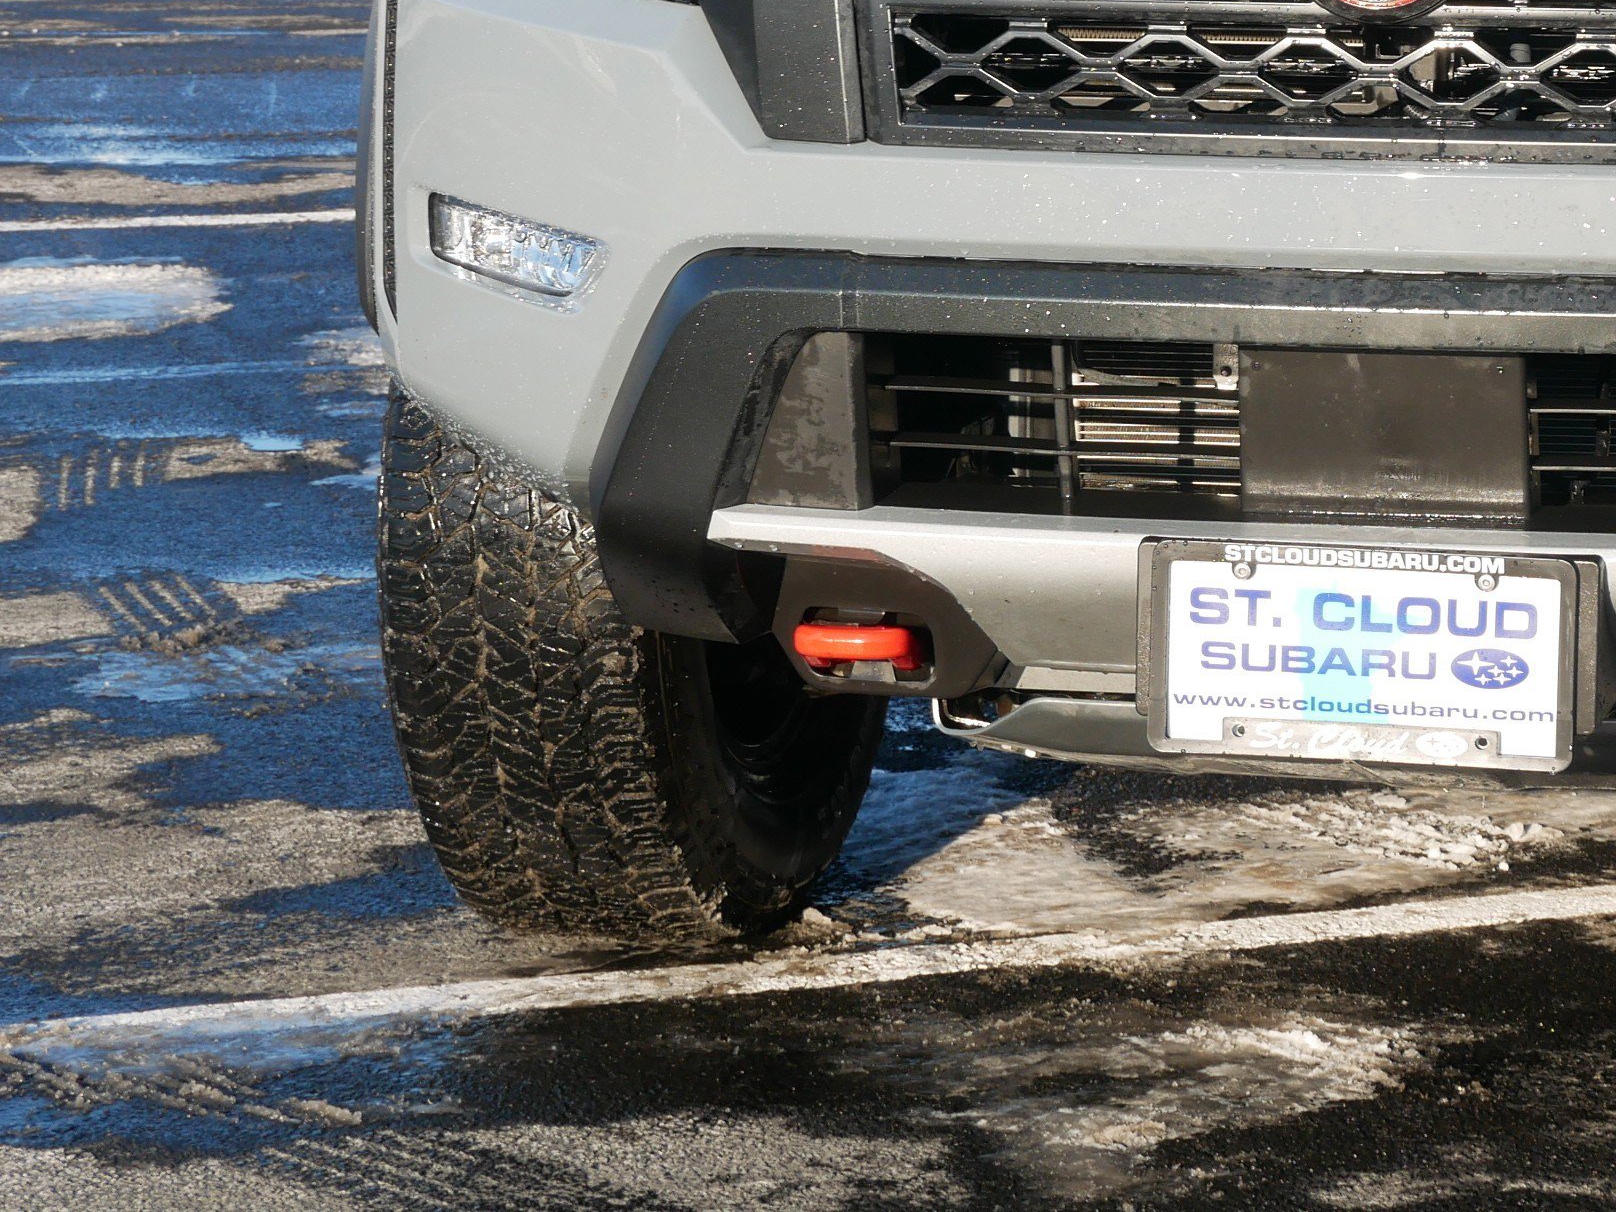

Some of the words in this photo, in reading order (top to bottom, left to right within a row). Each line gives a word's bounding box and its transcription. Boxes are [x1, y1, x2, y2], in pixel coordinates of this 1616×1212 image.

[1224, 544, 1506, 575] STCLOUDSUBARU.COM
[1189, 586, 1282, 628] ST.
[1312, 591, 1539, 640] CLOUD
[1200, 640, 1438, 681] SUBARU
[1173, 692, 1555, 723] www.stcloudsubaru.com
